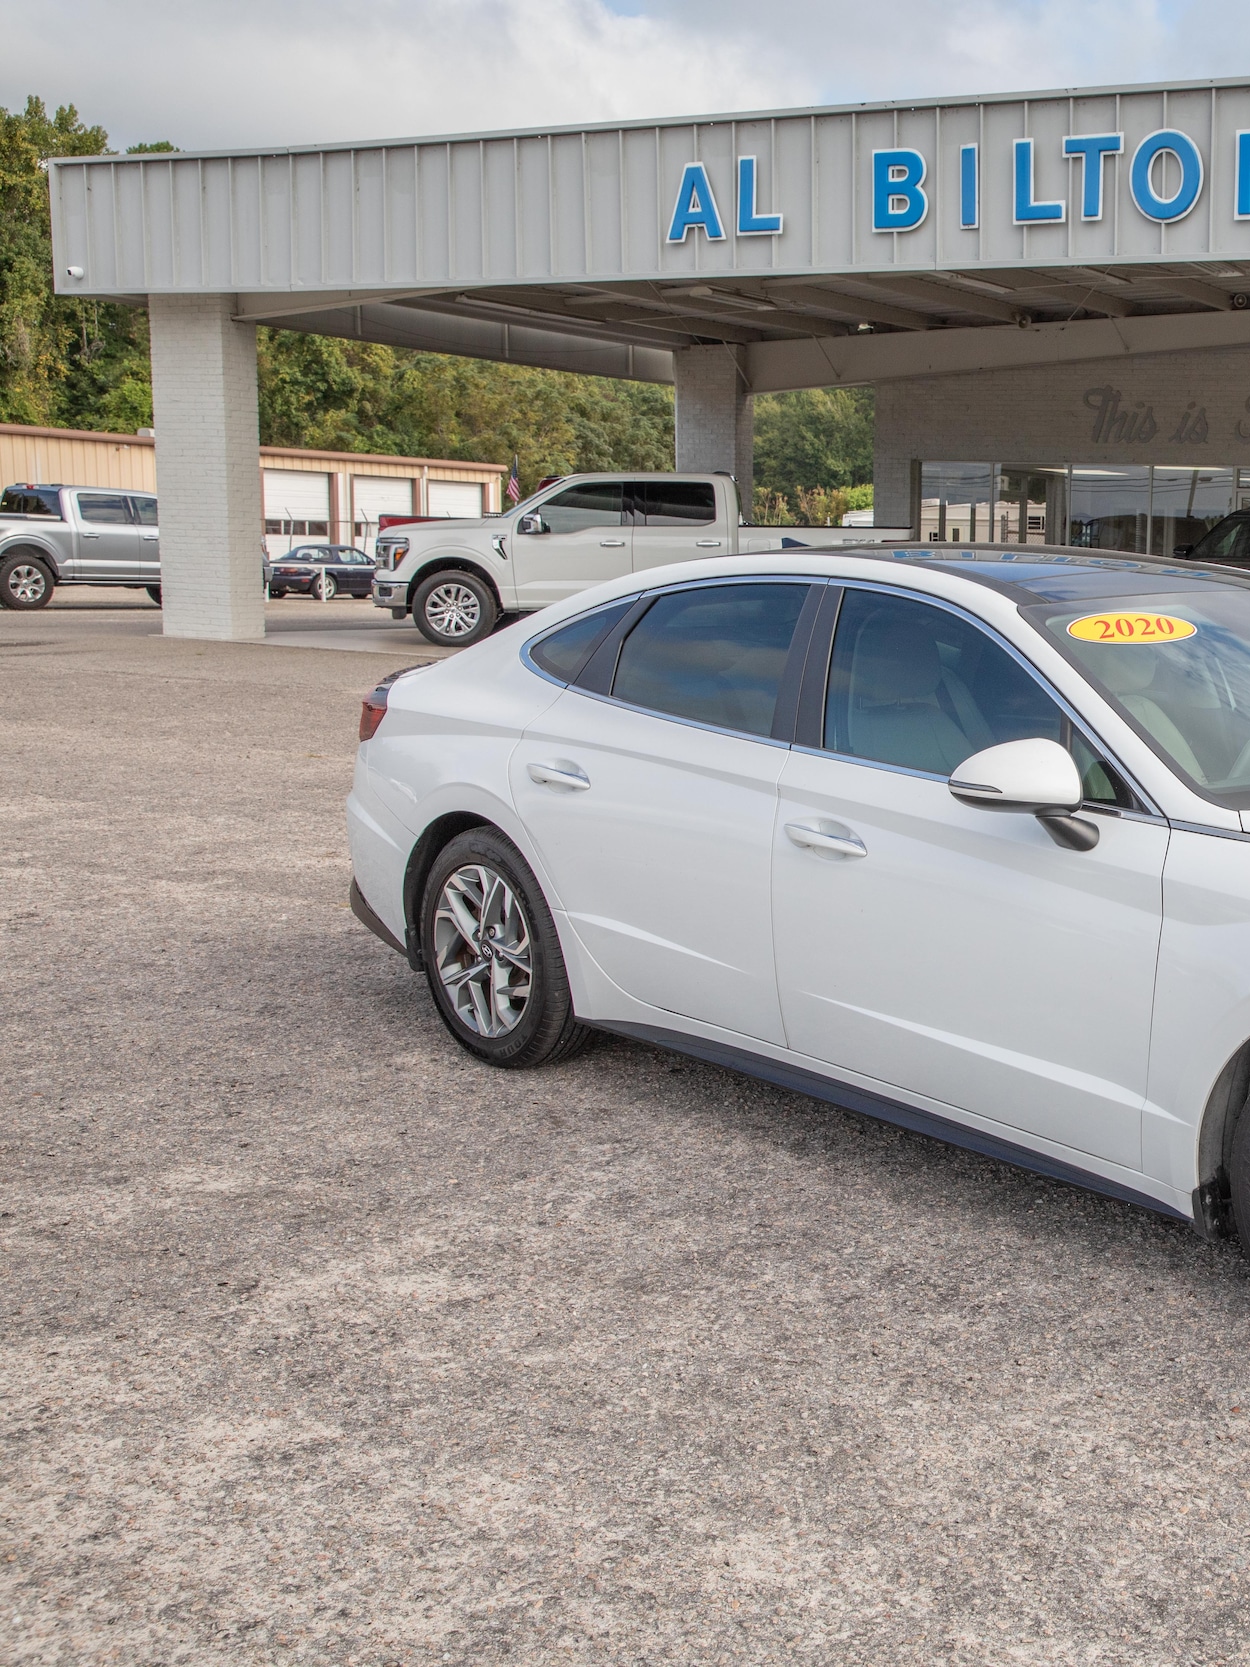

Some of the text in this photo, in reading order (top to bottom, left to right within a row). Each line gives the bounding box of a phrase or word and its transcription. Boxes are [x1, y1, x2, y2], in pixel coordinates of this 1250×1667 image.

[666, 155, 784, 244] AL
[1083, 384, 1157, 444] This
[1168, 401, 1209, 444] is
[1094, 617, 1175, 640] 2020
